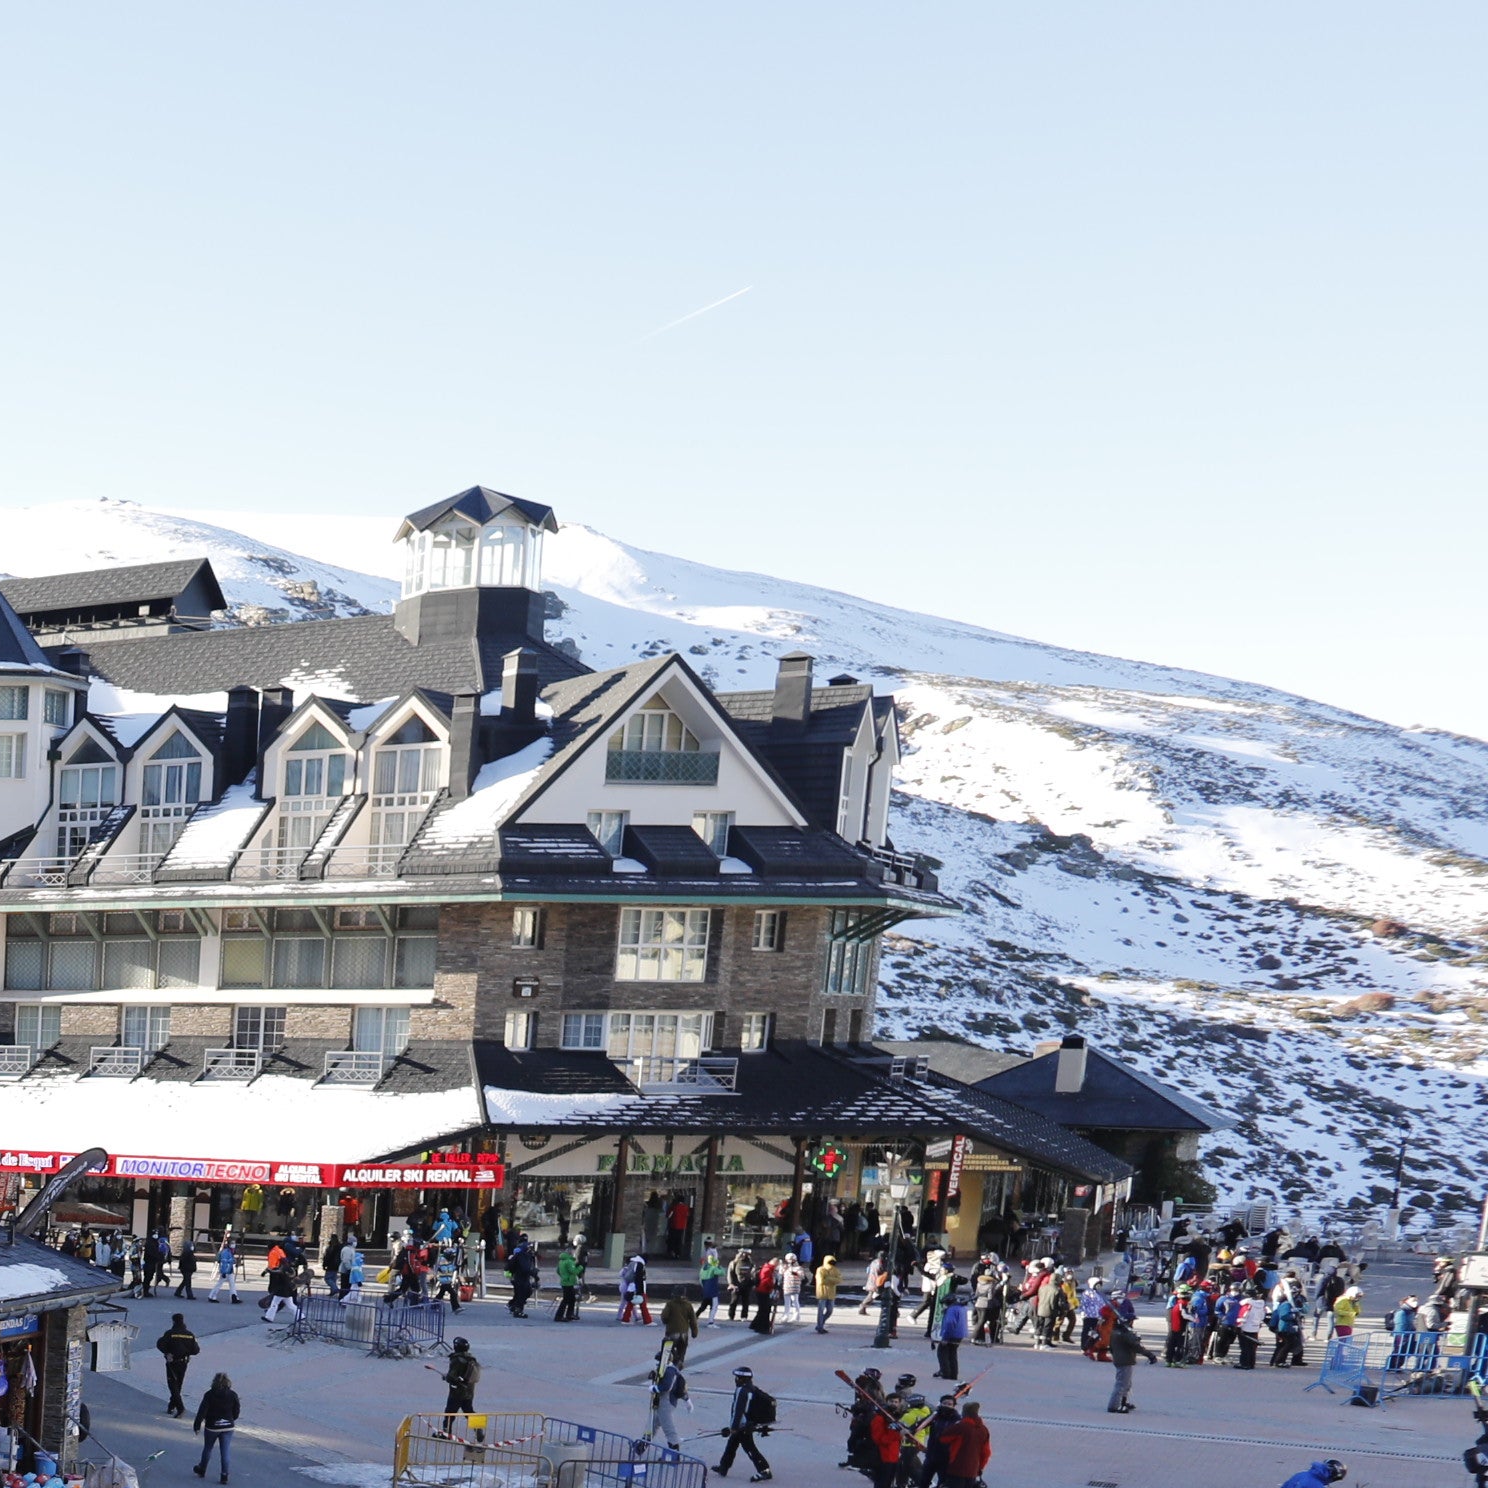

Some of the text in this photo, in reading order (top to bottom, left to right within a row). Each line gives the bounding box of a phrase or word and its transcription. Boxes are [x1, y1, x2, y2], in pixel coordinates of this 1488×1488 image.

[2, 1152, 18, 1166] de
[947, 1136, 965, 1197] VERTICAL
[342, 1168, 472, 1183] ALQUILER SKI RENTAL
